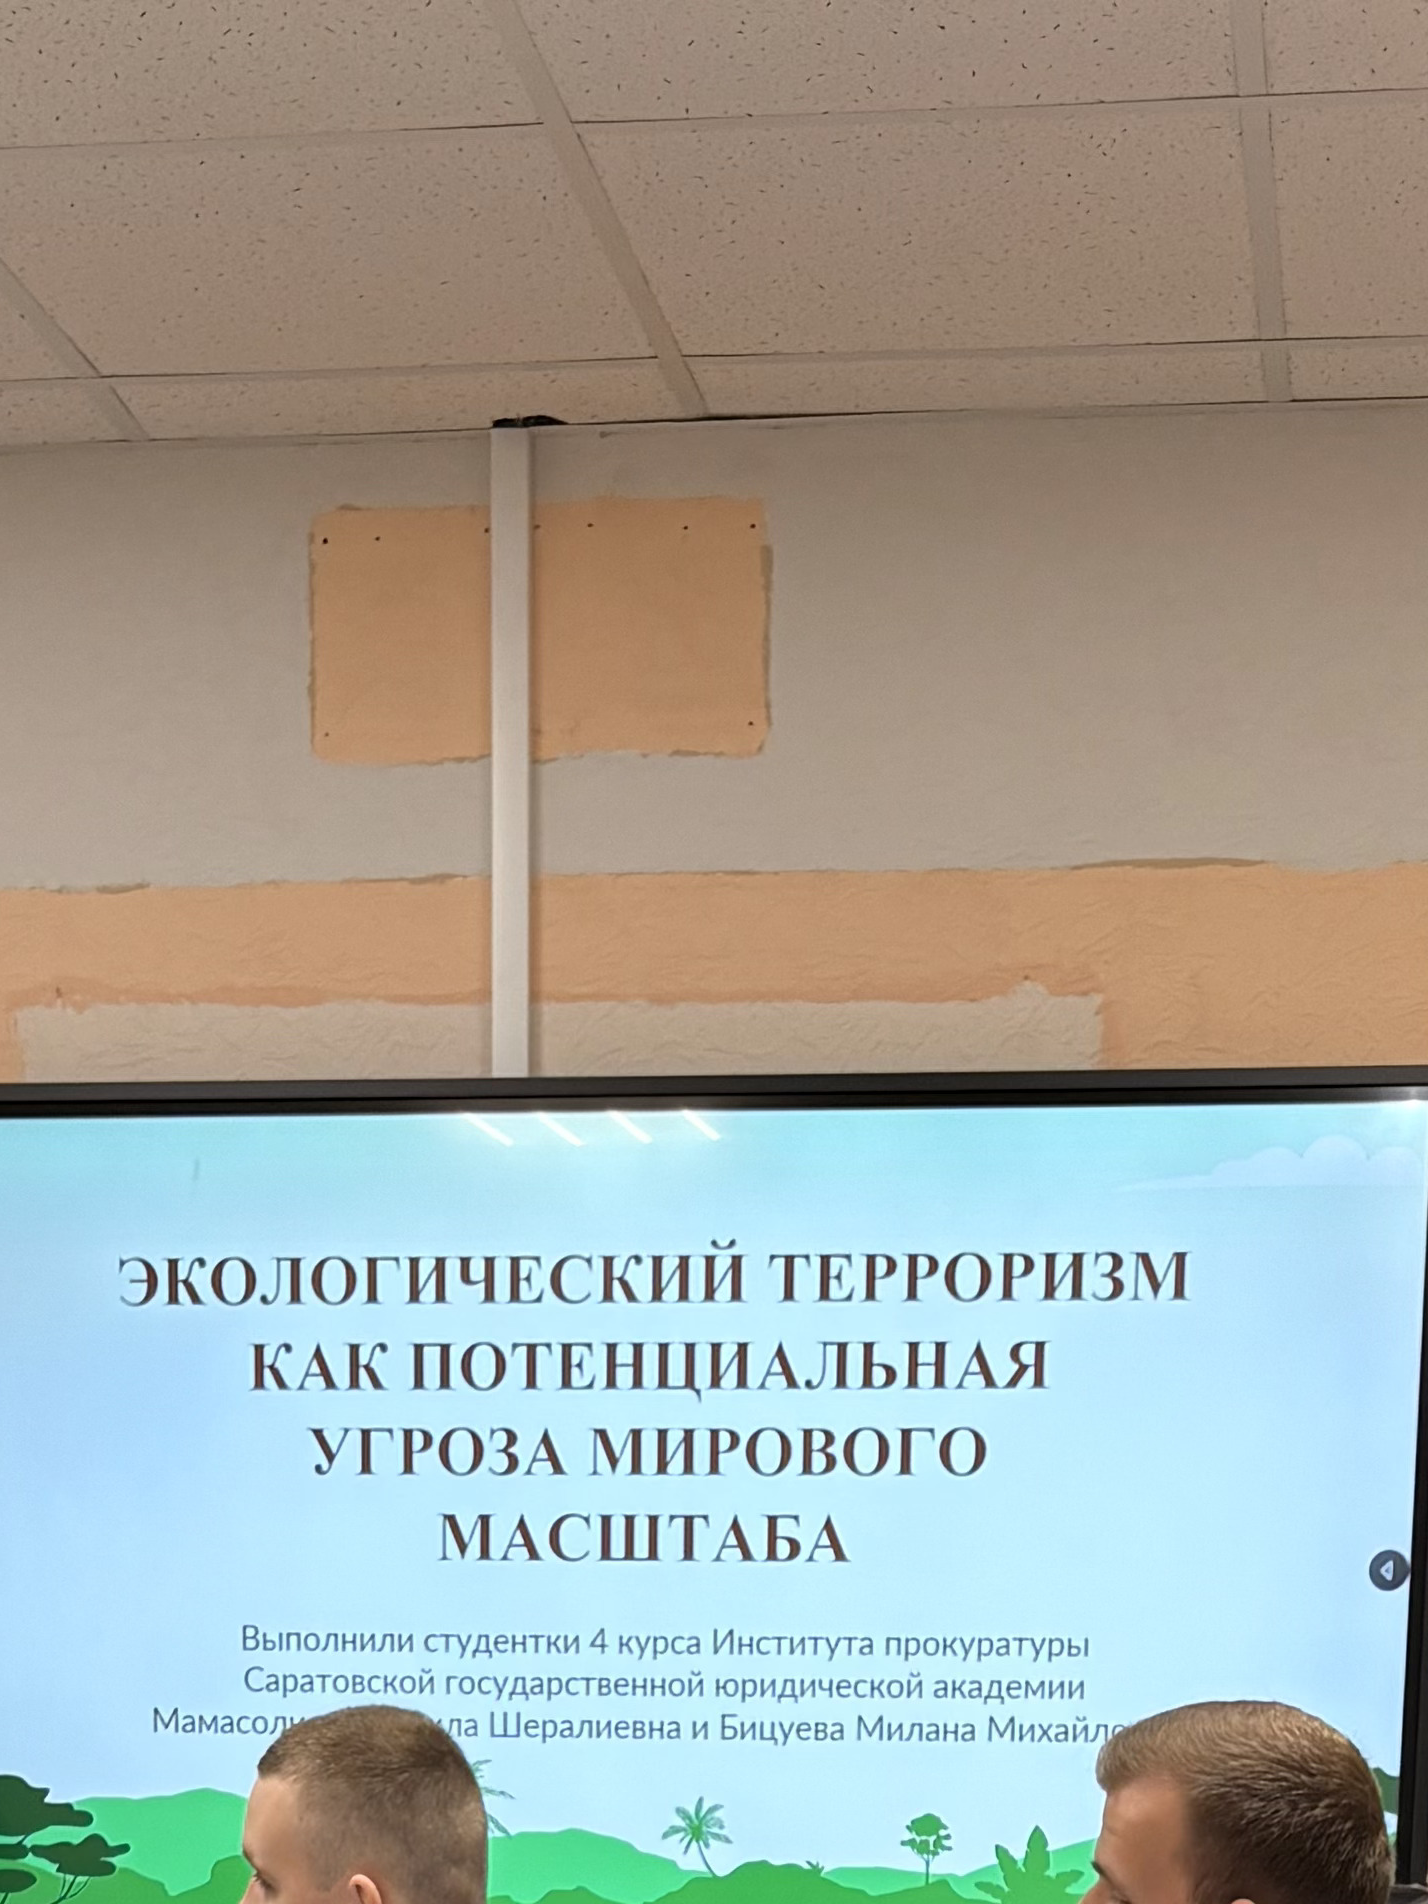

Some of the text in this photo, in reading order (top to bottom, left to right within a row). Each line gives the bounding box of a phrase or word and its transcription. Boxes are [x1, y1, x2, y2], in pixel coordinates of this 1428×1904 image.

[119, 1239, 1190, 1306] ЭКОЛОГИЧЕСКИЙ ТЕРРОРИЗМ
[250, 1340, 1050, 1402] КАК ПОТЕНЦИАЛЬНАЯ
[308, 1426, 987, 1478] УГРОЗА МИРОВОГО
[438, 1512, 850, 1563] МАСШТАБА
[241, 1624, 1090, 1663] Выполнили студентки 4 курса Института прокуратуры
[243, 1666, 1085, 1706] Саратовской государственной юридической академии
[489, 1711, 682, 1744] Шералиевна
[691, 1720, 709, 1741] и
[720, 1713, 845, 1747] Бицуева
[856, 1715, 976, 1743] Милана
